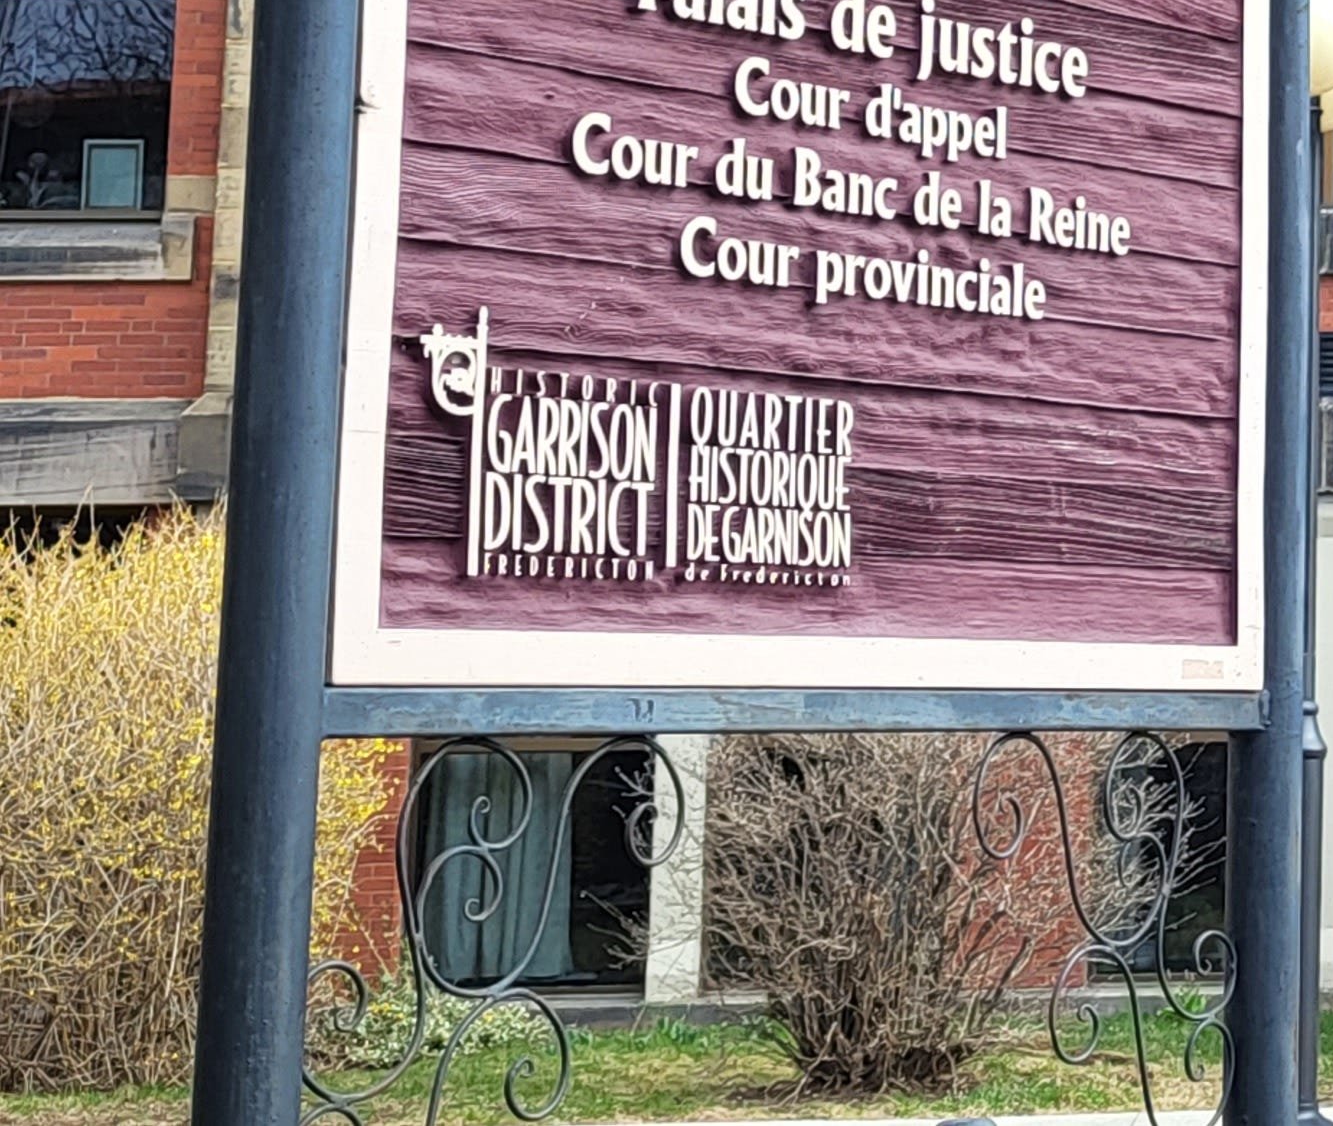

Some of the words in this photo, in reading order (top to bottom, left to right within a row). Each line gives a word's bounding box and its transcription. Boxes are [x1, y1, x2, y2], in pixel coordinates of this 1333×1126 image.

[734, 56, 850, 130] Cour
[865, 84, 1007, 162] d'appel
[572, 112, 698, 187] Cour
[715, 138, 773, 201] du
[793, 146, 897, 220] Banc
[914, 171, 962, 229] de
[977, 179, 1012, 238] la
[1029, 187, 1131, 256] Reine
[680, 216, 800, 288] Cour
[816, 250, 1047, 320] provinciale
[490, 367, 659, 407] HISTORIC
[690, 386, 854, 454] QUARTIER
[487, 393, 658, 480] GARRISON
[484, 471, 654, 556] DISTRICT
[689, 446, 852, 512] HISTORIQUE
[483, 553, 653, 580] FREDERICTON
[685, 566, 711, 582] de
[720, 567, 851, 586] Fredericton
